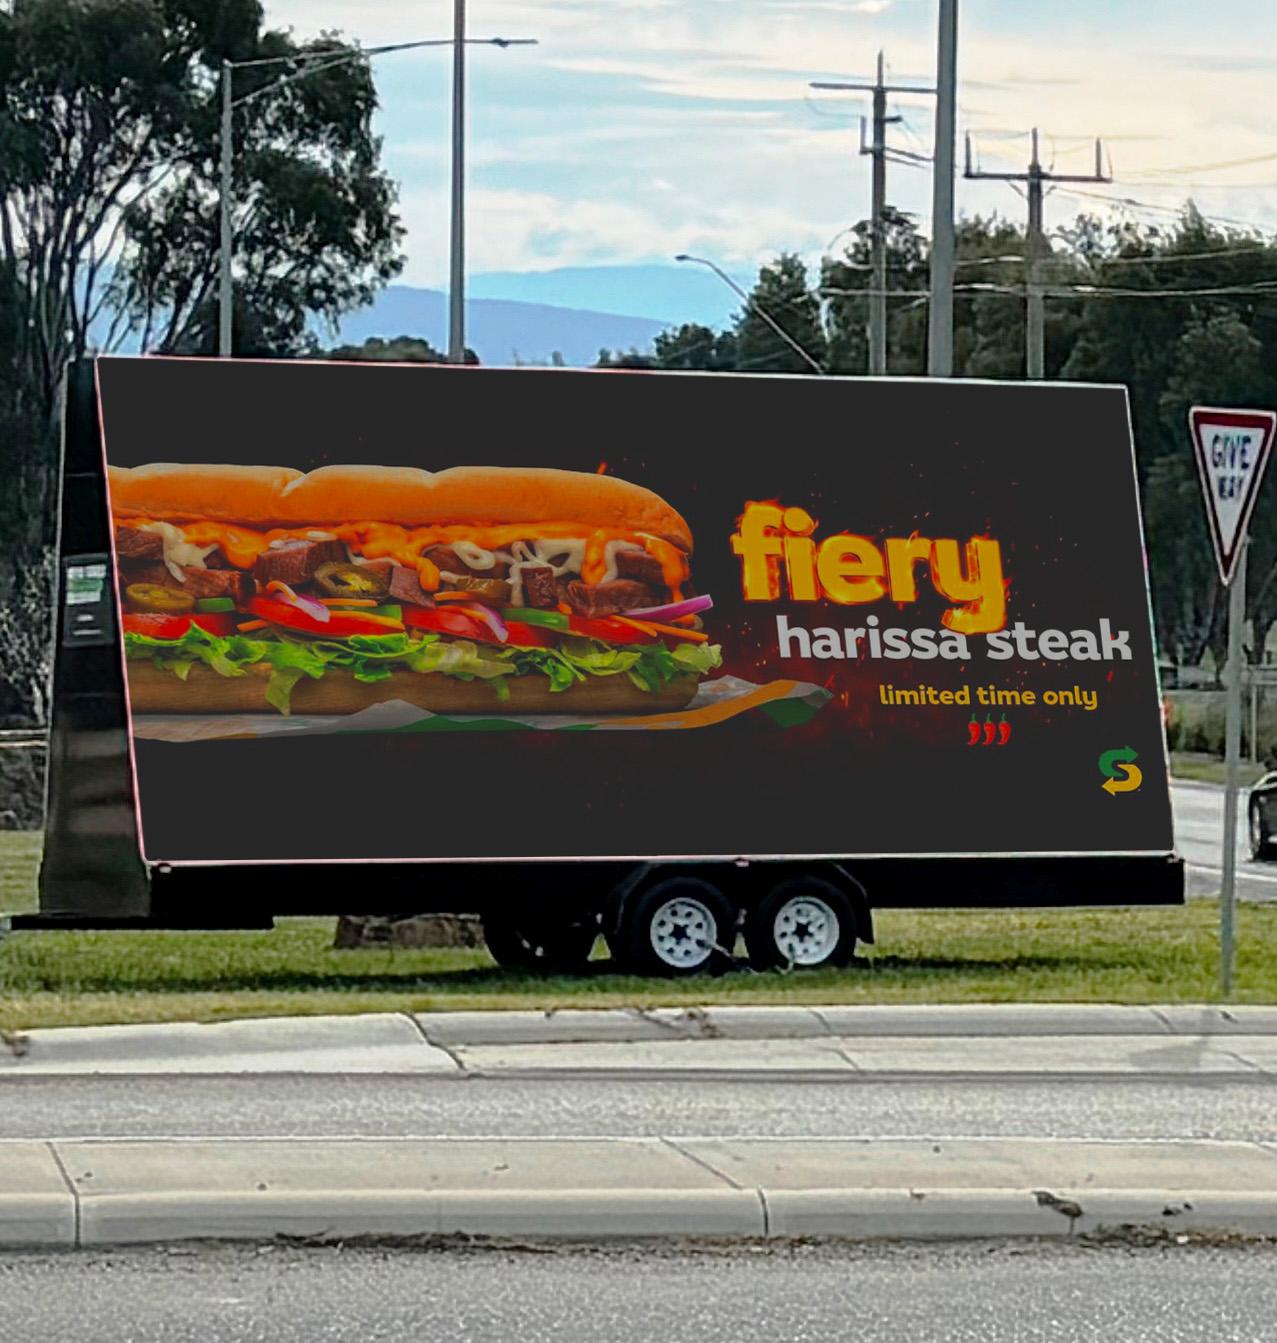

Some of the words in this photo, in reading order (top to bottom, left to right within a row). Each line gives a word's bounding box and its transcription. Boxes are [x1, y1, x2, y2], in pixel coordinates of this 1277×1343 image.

[1212, 434, 1252, 470] GIVE
[731, 501, 1007, 635] fiery
[776, 614, 972, 660] harissa
[986, 618, 1133, 661] steak
[879, 684, 971, 706] limited
[976, 686, 1037, 706] time
[1043, 685, 1099, 711] only
